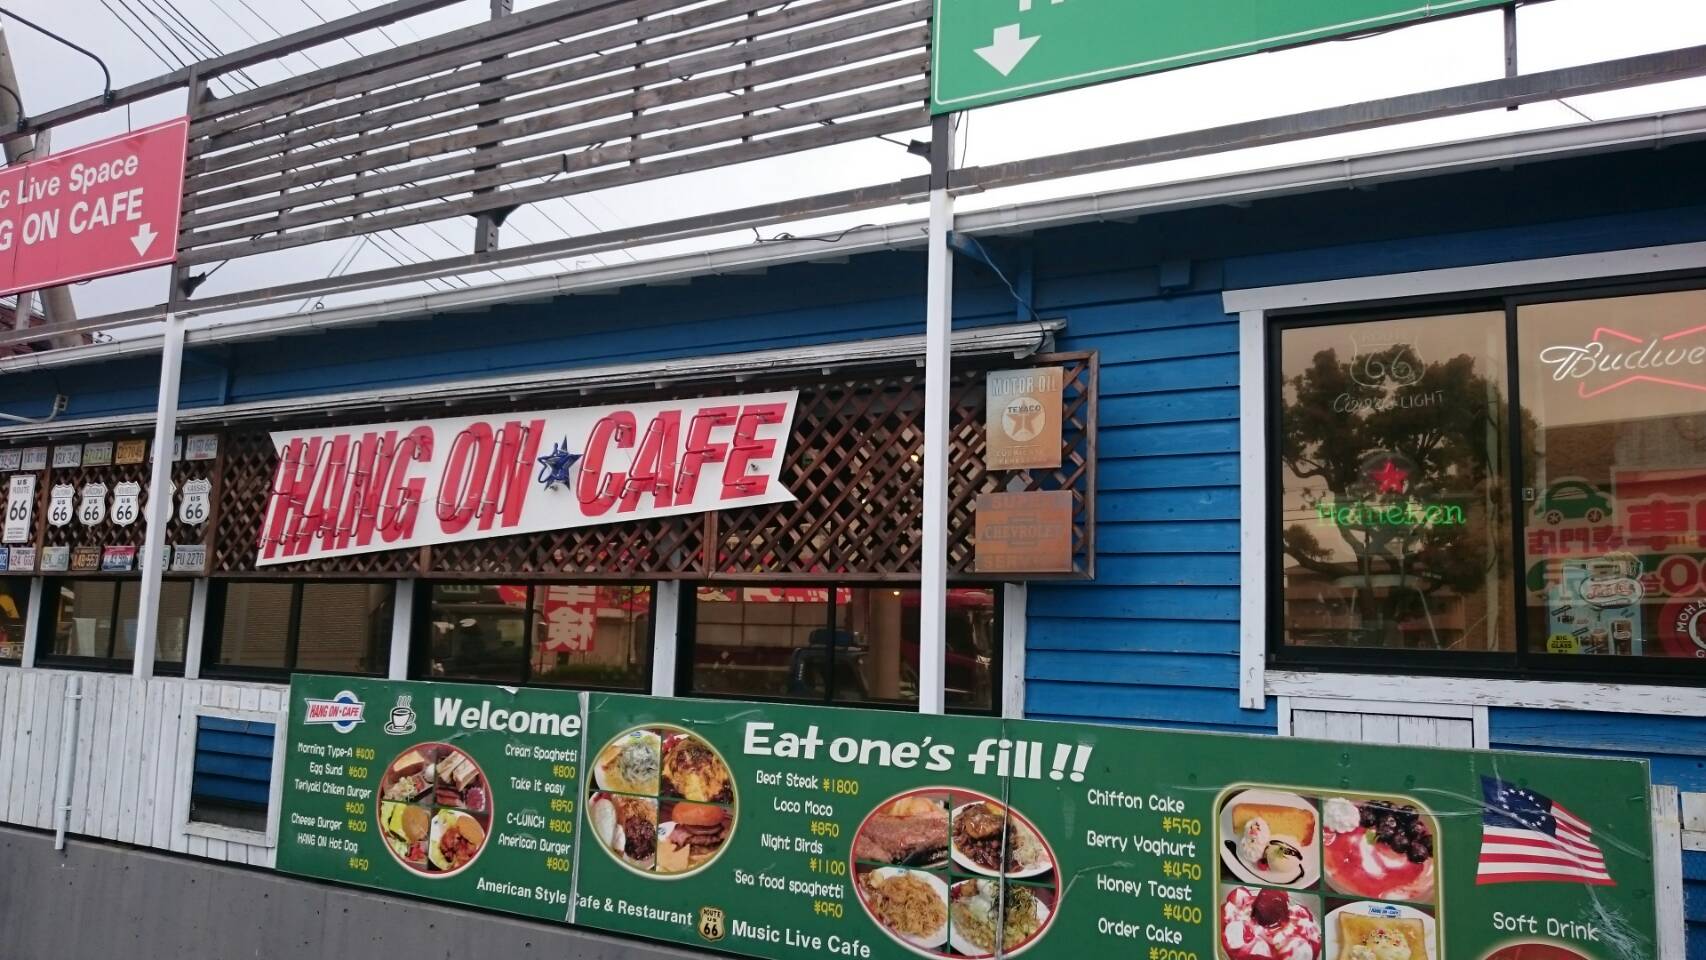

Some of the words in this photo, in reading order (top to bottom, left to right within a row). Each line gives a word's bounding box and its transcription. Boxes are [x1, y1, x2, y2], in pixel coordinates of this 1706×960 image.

[17, 177, 60, 205] Live
[69, 154, 139, 194] Space
[23, 208, 59, 245] ON
[69, 187, 144, 234] CAFE
[1365, 347, 1412, 379] 66
[992, 377, 1034, 396] MOTOR
[1039, 376, 1058, 393] OIL
[1007, 404, 1041, 414] TEXACO
[260, 424, 435, 559] HANG
[437, 418, 546, 535] ON
[575, 402, 788, 517] CAFE
[10, 500, 27, 520] 66
[53, 507, 67, 521] 66
[84, 506, 99, 520] 66
[116, 505, 133, 520] 66
[186, 503, 203, 519] 66
[309, 704, 329, 718] HANG
[342, 706, 360, 717] CAFE
[434, 697, 581, 737] Welcome
[298, 742, 325, 757] Morning
[328, 745, 353, 758] Type-A
[505, 743, 531, 758] Cream
[533, 746, 577, 762] Spaghetti
[744, 722, 823, 759] Eat
[829, 736, 956, 771] one's
[968, 738, 1093, 783] fill!!
[309, 761, 323, 775] Egg
[325, 763, 344, 776] Sund
[295, 778, 321, 793] Teriyaki
[346, 785, 372, 800] Burger
[510, 777, 532, 790] Take
[533, 779, 542, 792] it
[544, 782, 566, 796] easy
[786, 772, 819, 789] Steak
[823, 778, 859, 795] ¥1800
[774, 797, 800, 813] Loco
[805, 800, 833, 817] Moco
[1087, 789, 1143, 809] Chiffon
[1148, 794, 1185, 814] Cake
[291, 812, 316, 827] Cheese
[317, 816, 343, 831] Burger
[506, 812, 545, 829] C-LUNCH
[811, 821, 839, 837] ¥850
[1162, 816, 1201, 836] ¥550
[297, 832, 316, 845] HANG
[317, 835, 328, 848] ON
[329, 837, 342, 850] Hot
[344, 839, 359, 854] Dog
[497, 833, 537, 850] American
[539, 838, 571, 855] Burger
[761, 833, 790, 851] Night
[794, 837, 823, 854] Birds
[1087, 830, 1128, 852] Berry
[1133, 835, 1196, 857] Yoghurt
[809, 858, 846, 875] ¥1100
[1163, 860, 1201, 880] ¥450
[735, 870, 755, 886] Sea
[758, 873, 785, 890] food
[788, 880, 844, 899] spaghetti
[1097, 874, 1142, 897] Honey
[1148, 881, 1193, 901] Toast
[476, 877, 532, 898] American
[535, 886, 567, 904] Style
[604, 898, 614, 912] &
[618, 900, 693, 925] Restaurant
[703, 908, 721, 917] ROUTE
[1163, 904, 1202, 924] ¥400
[704, 923, 718, 936] 66
[1098, 917, 1140, 938] Order
[1146, 924, 1183, 944] Cake
[1493, 911, 1538, 934] Soft
[1547, 918, 1600, 941] Drink
[732, 919, 780, 942] Music
[785, 928, 822, 949] Live
[828, 935, 871, 958] Cafe
